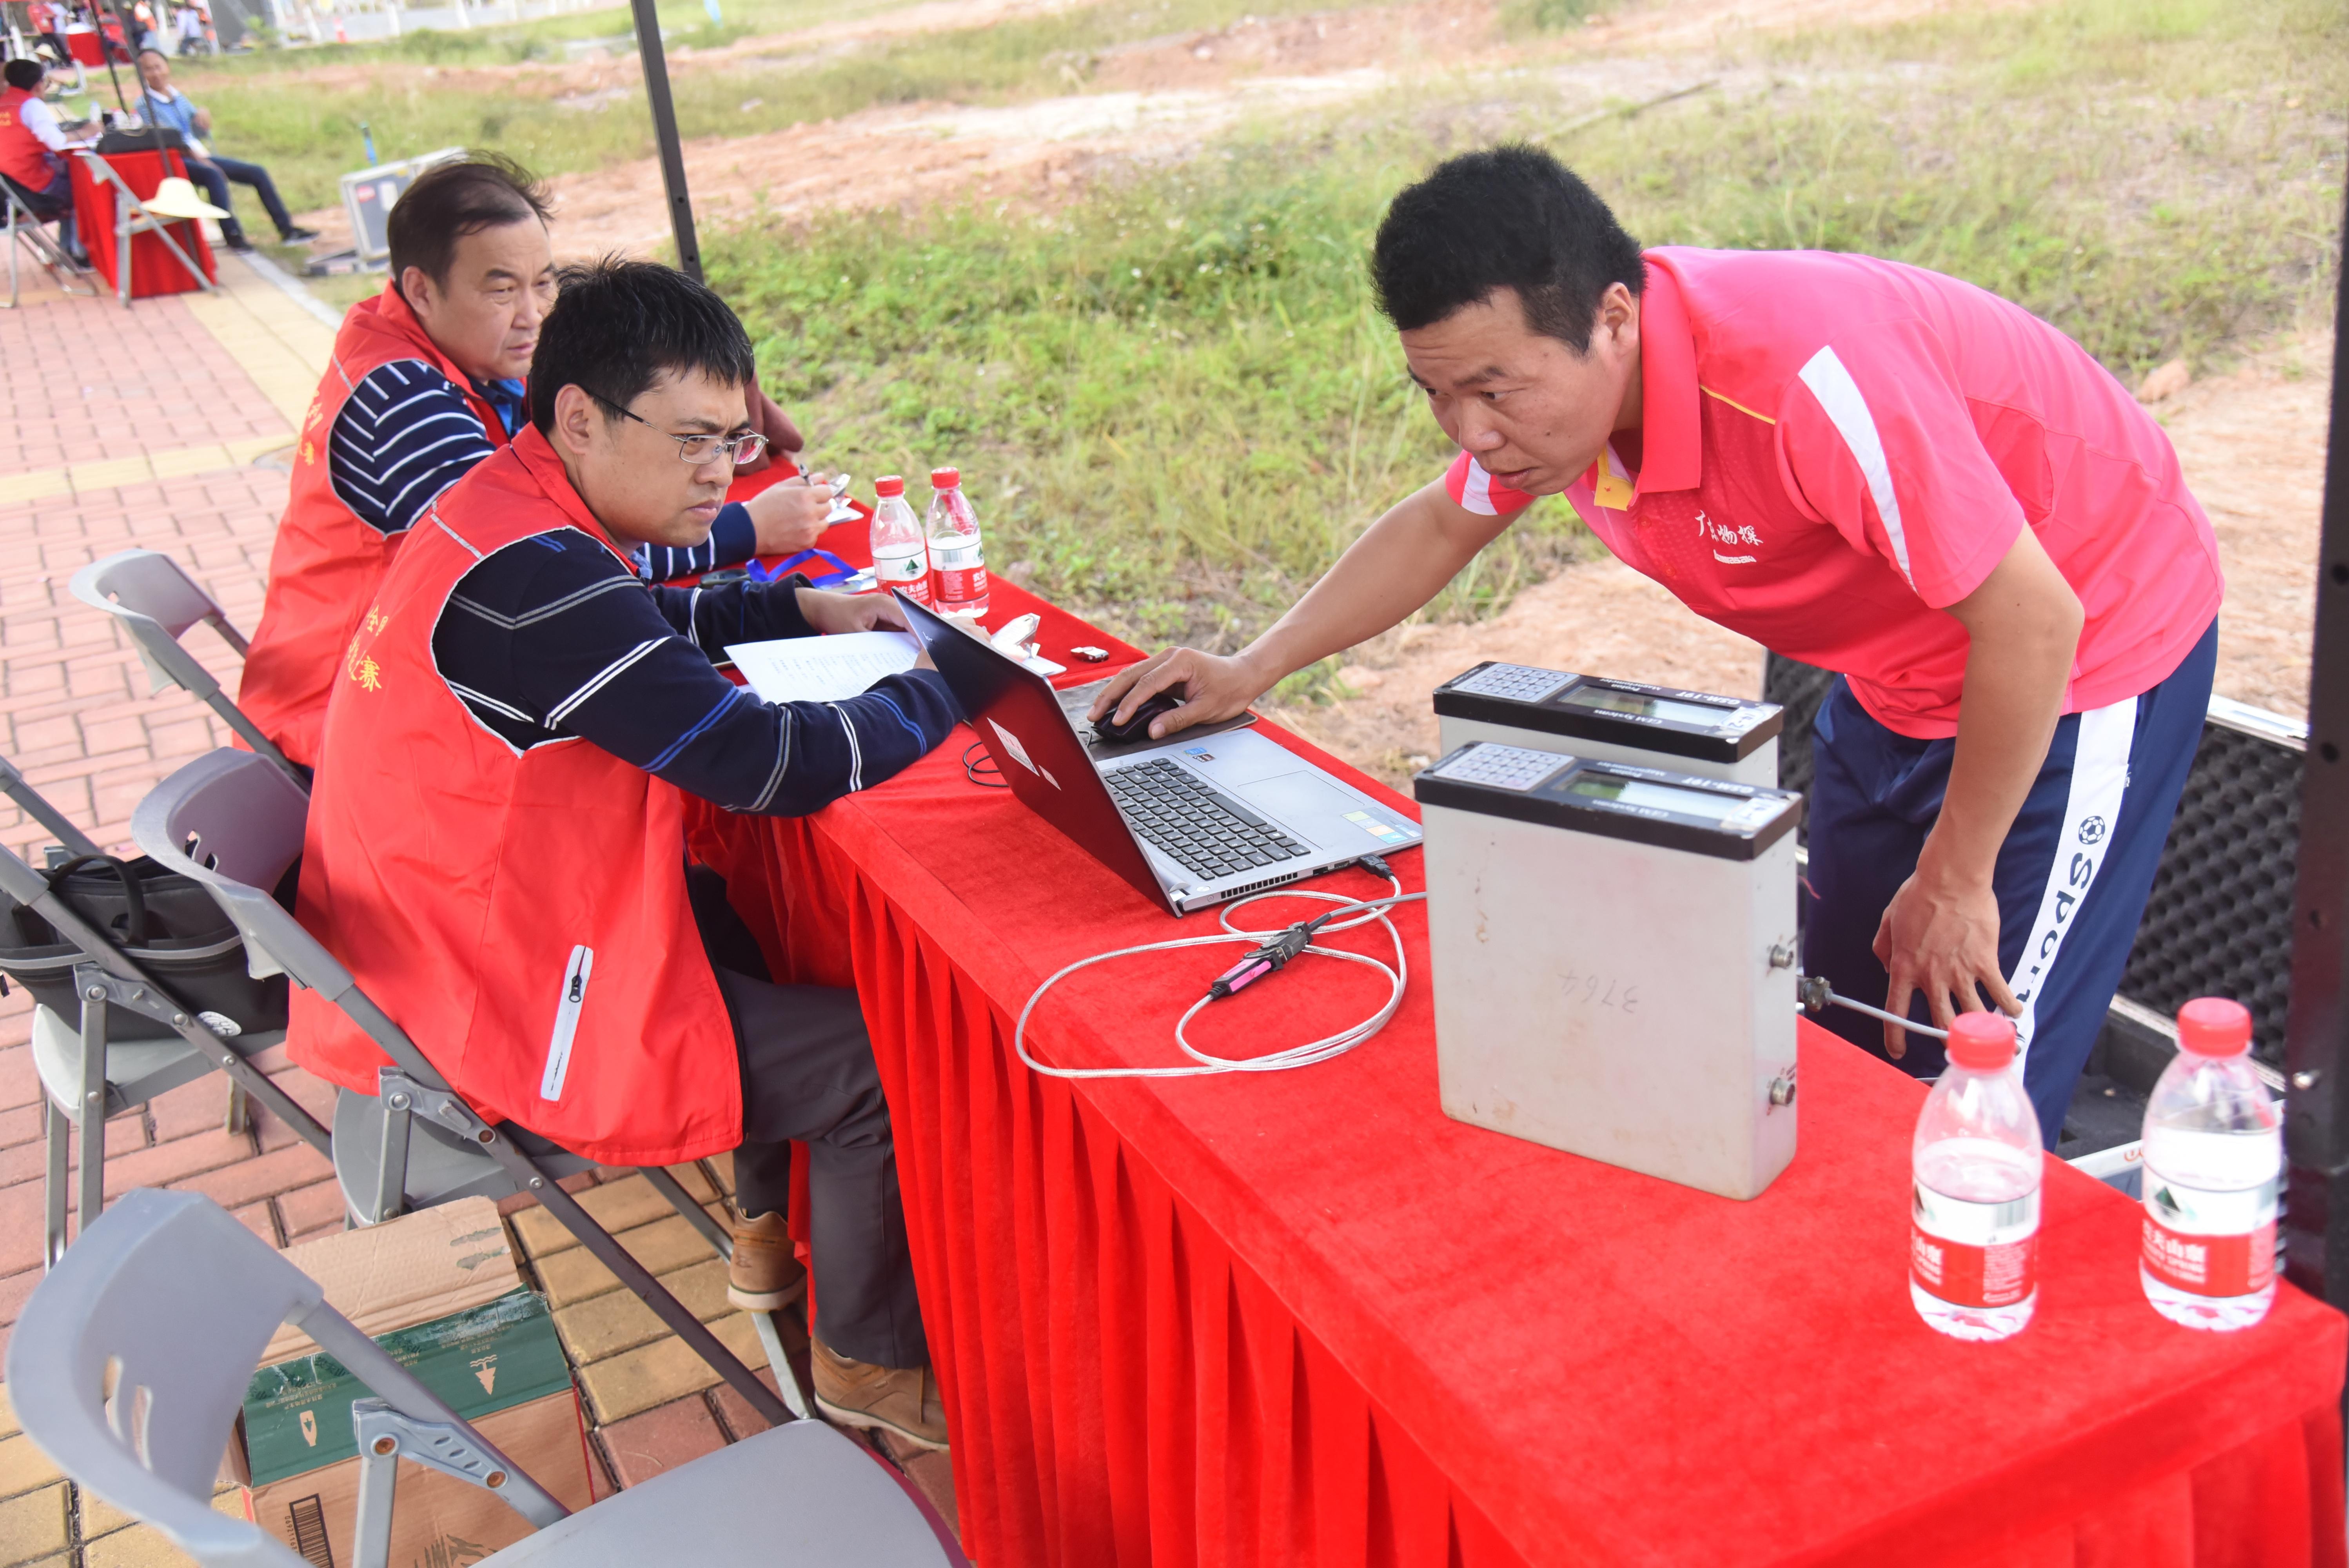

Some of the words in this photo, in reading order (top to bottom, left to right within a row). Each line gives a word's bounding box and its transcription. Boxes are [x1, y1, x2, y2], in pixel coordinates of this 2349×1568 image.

[1676, 691, 1741, 705] GSM-19T
[1593, 708, 1635, 720] Systems
[1636, 716, 1663, 725] GEM
[1681, 777, 1756, 793] GSM-19T
[1558, 972, 1641, 1014] 3764
